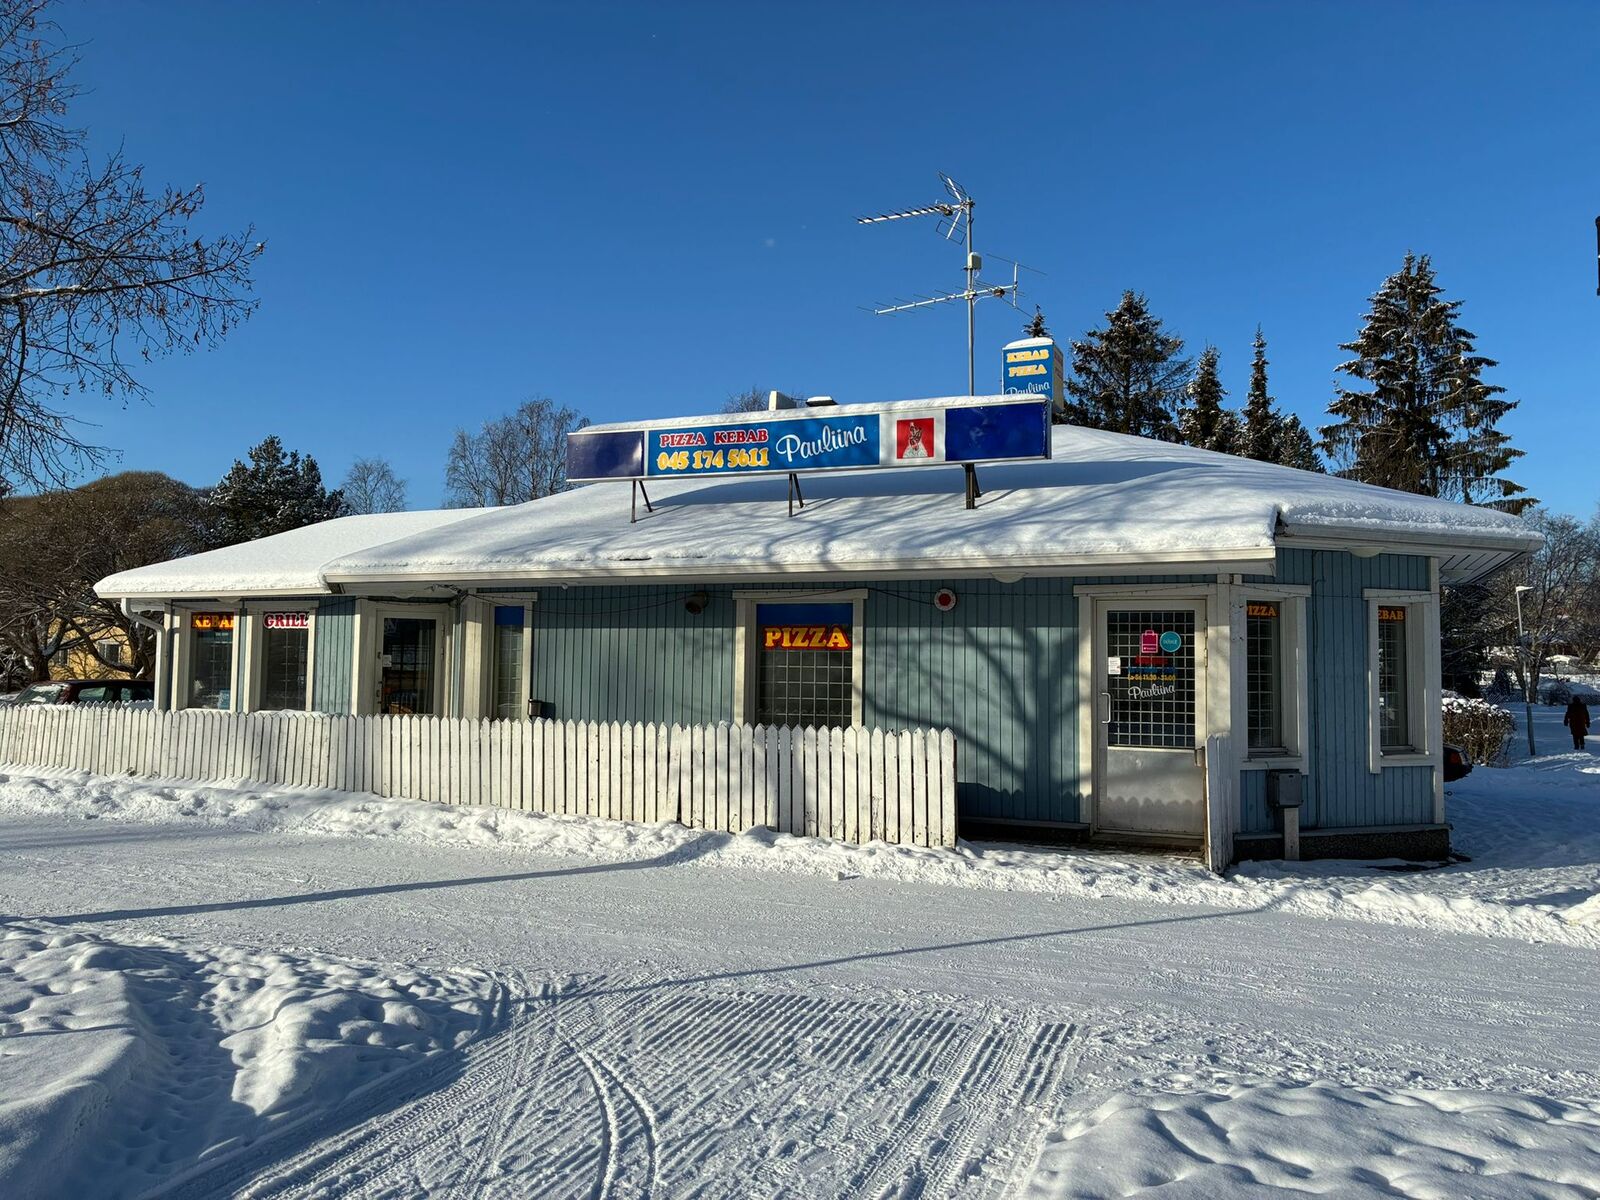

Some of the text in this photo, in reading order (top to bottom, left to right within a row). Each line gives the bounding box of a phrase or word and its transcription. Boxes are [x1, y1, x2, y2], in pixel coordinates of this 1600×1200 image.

[1008, 364, 1047, 377] PIZZA
[660, 428, 769, 447] PIZZA KEBAB
[775, 425, 867, 462] Pauliina
[657, 447, 769, 471] 045 174 5611
[1247, 605, 1276, 616] IZZA
[1378, 609, 1404, 620] EBAB
[264, 613, 309, 629] GRILL
[765, 627, 848, 647] PIZZA
[1128, 684, 1175, 699] Pauliina
